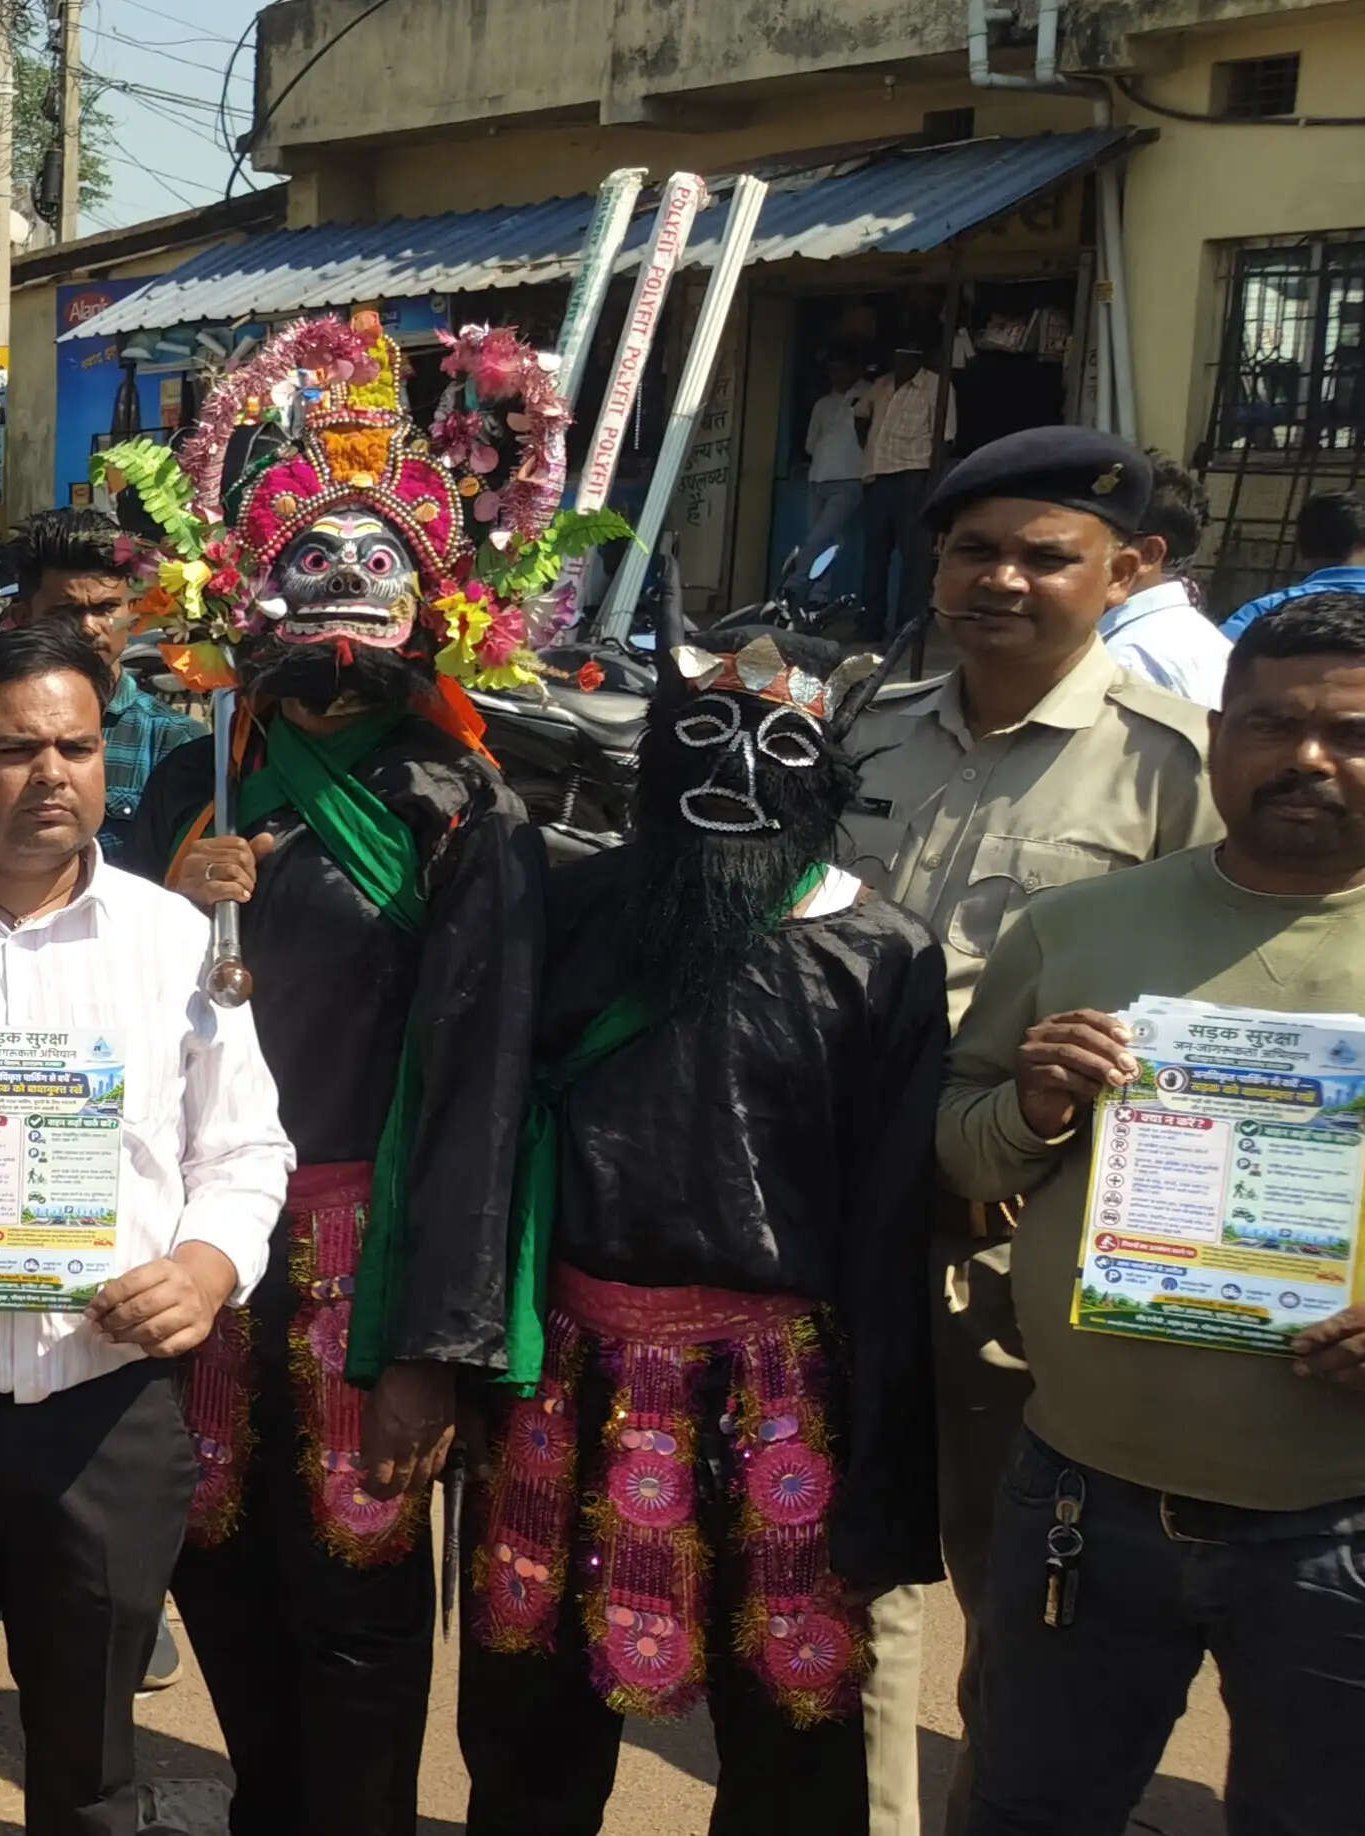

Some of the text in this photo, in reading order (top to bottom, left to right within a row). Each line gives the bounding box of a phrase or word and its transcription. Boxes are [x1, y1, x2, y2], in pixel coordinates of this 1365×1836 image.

[657, 186, 691, 254] POLYFIT
[632, 265, 666, 335] POLYFIT
[607, 343, 642, 417] POLYFIT
[586, 427, 620, 497] POLYFIT
[25, 1032, 69, 1048] सुरक्षा
[1188, 1024, 1301, 1048] सड़क सुरक्षा
[40, 1048, 77, 1059] अभियान
[13, 1083, 26, 1093] को
[1140, 1112, 1205, 1128] क्या न करें ?
